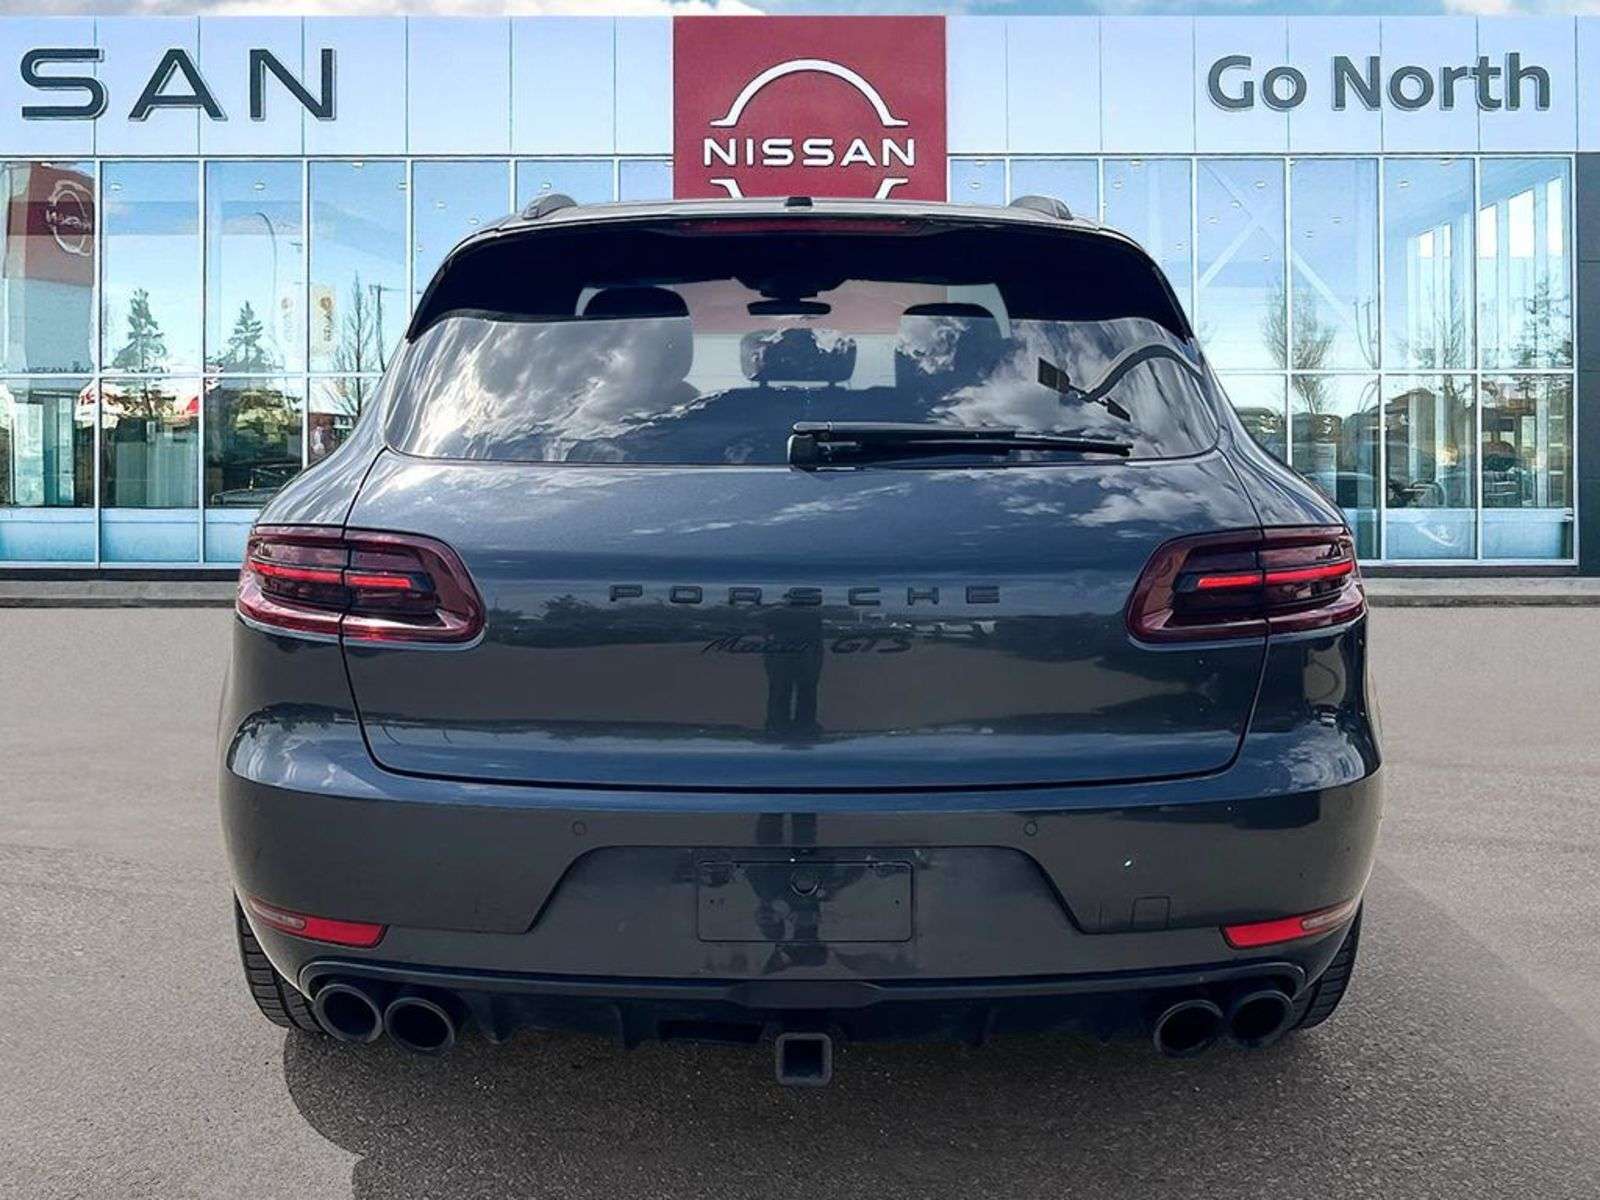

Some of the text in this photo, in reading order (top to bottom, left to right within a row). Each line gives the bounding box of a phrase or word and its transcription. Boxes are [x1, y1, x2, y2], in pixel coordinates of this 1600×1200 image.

[20, 48, 337, 121] SAN
[1207, 52, 1551, 111] Go North
[703, 137, 915, 167] NISSAN
[609, 584, 1002, 606] PORSCHE
[830, 635, 912, 654] GTS
